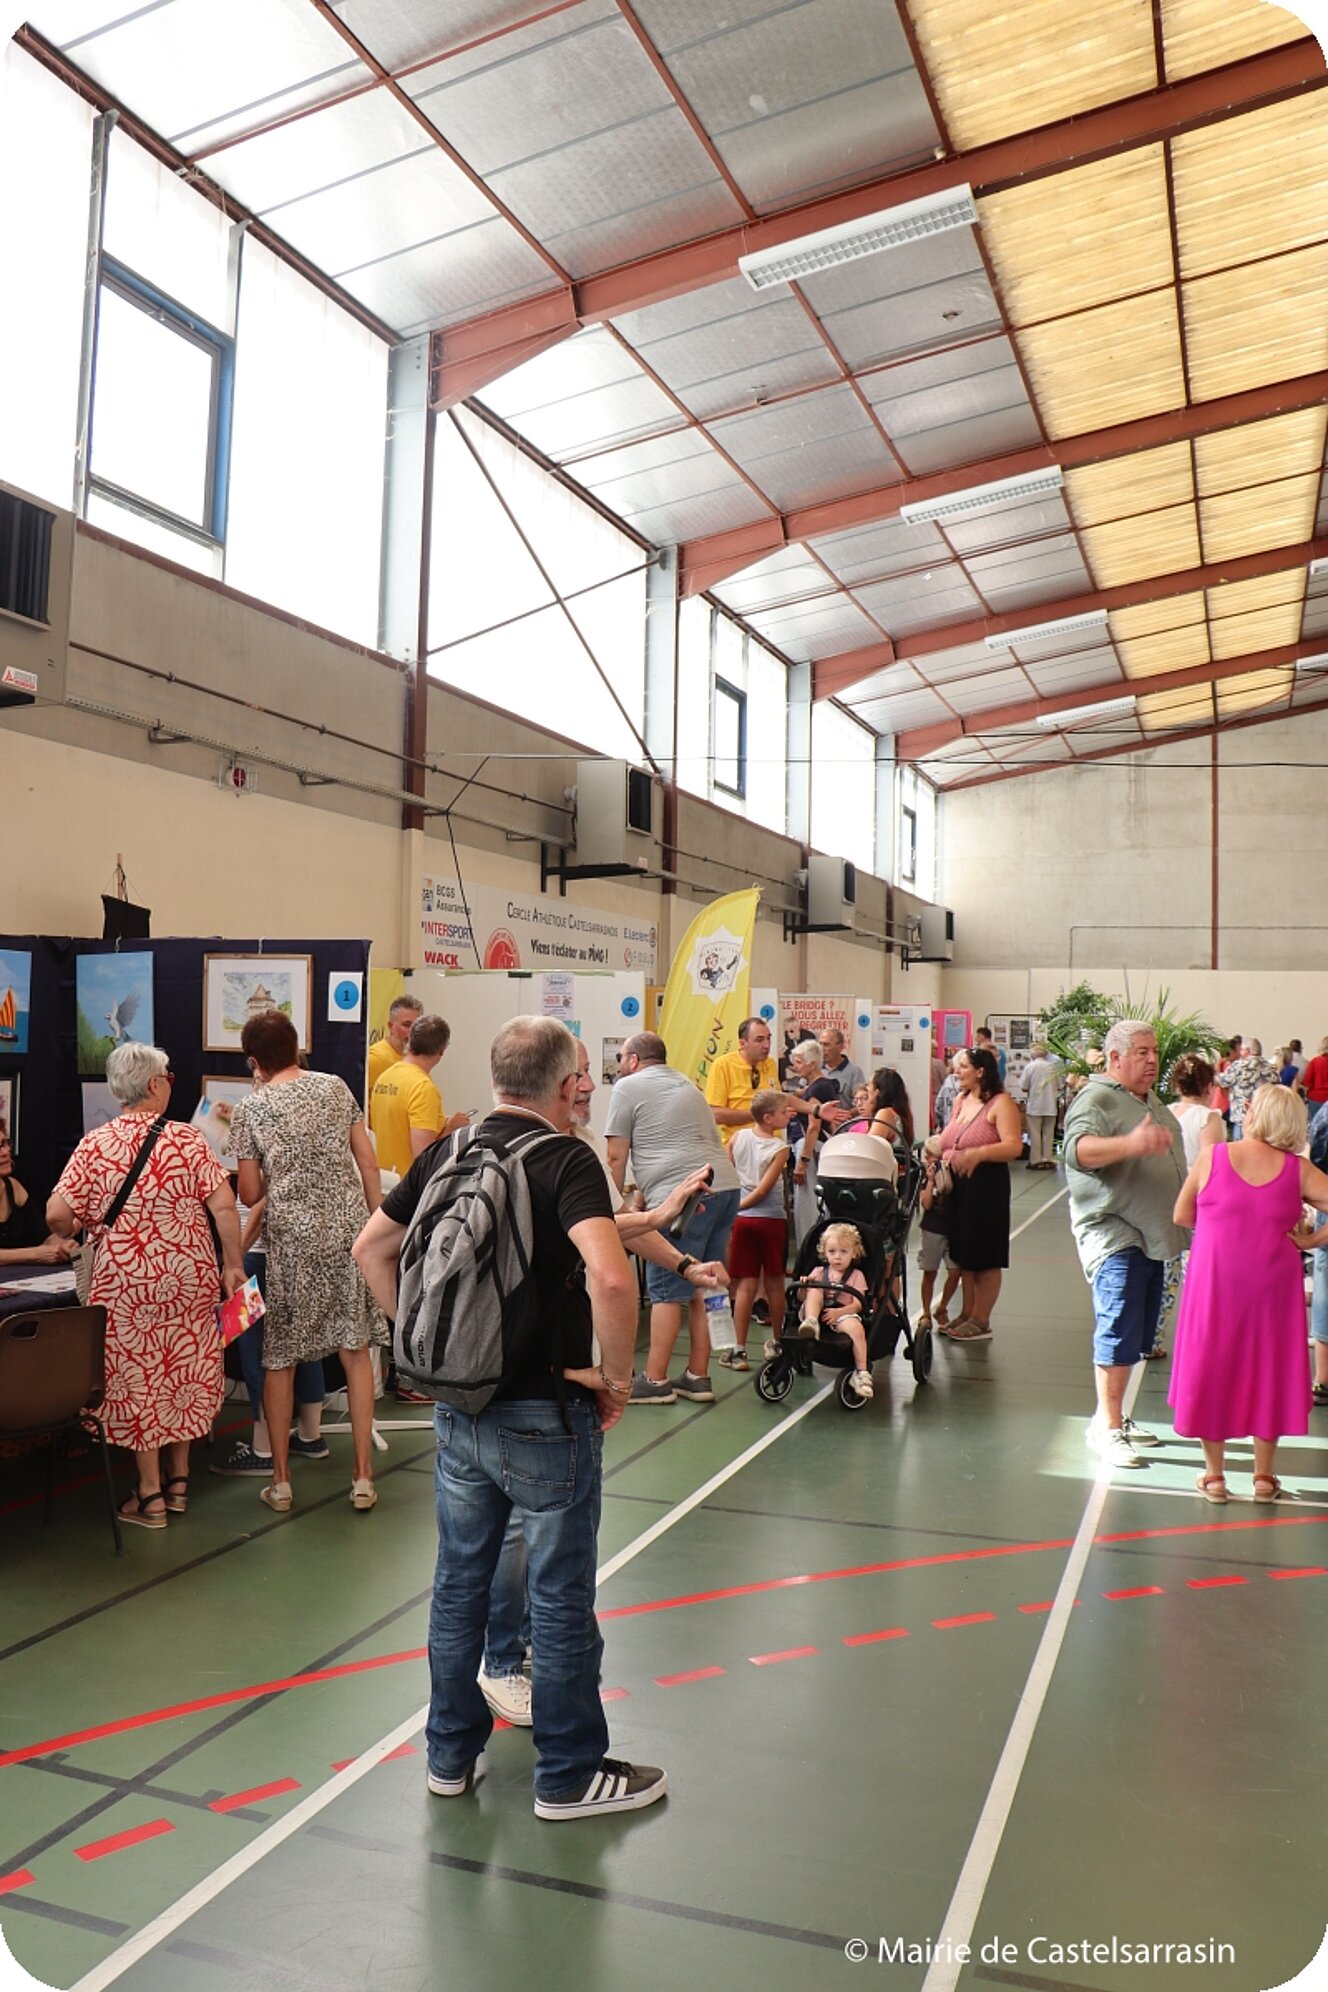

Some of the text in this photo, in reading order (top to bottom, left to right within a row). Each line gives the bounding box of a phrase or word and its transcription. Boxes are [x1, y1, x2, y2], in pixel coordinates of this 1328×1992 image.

[436, 884, 455, 899] BCGS
[424, 951, 459, 966] WACK
[795, 1001, 826, 1010] BRIDGE
[820, 1011, 846, 1020] ALLEZ
